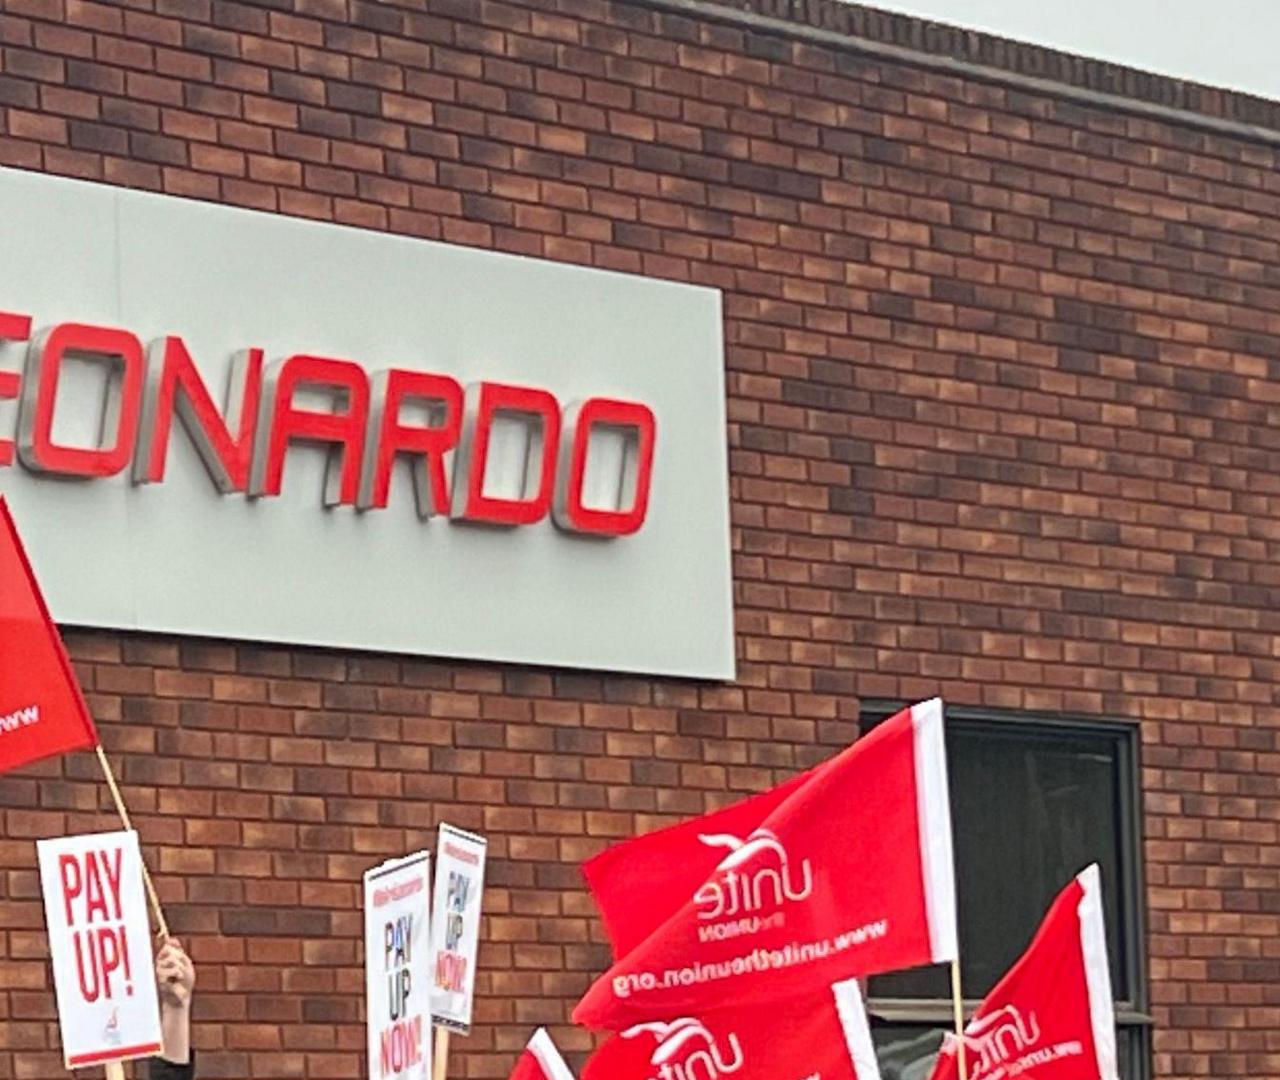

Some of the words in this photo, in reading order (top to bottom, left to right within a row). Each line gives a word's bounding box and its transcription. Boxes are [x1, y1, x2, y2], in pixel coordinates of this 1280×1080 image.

[58, 847, 123, 927] PAY
[73, 924, 135, 1004] UP!
[384, 911, 414, 972] PAY
[434, 950, 468, 995] NOW!
[388, 967, 411, 1022] UP
[378, 1013, 423, 1080] NOW!
